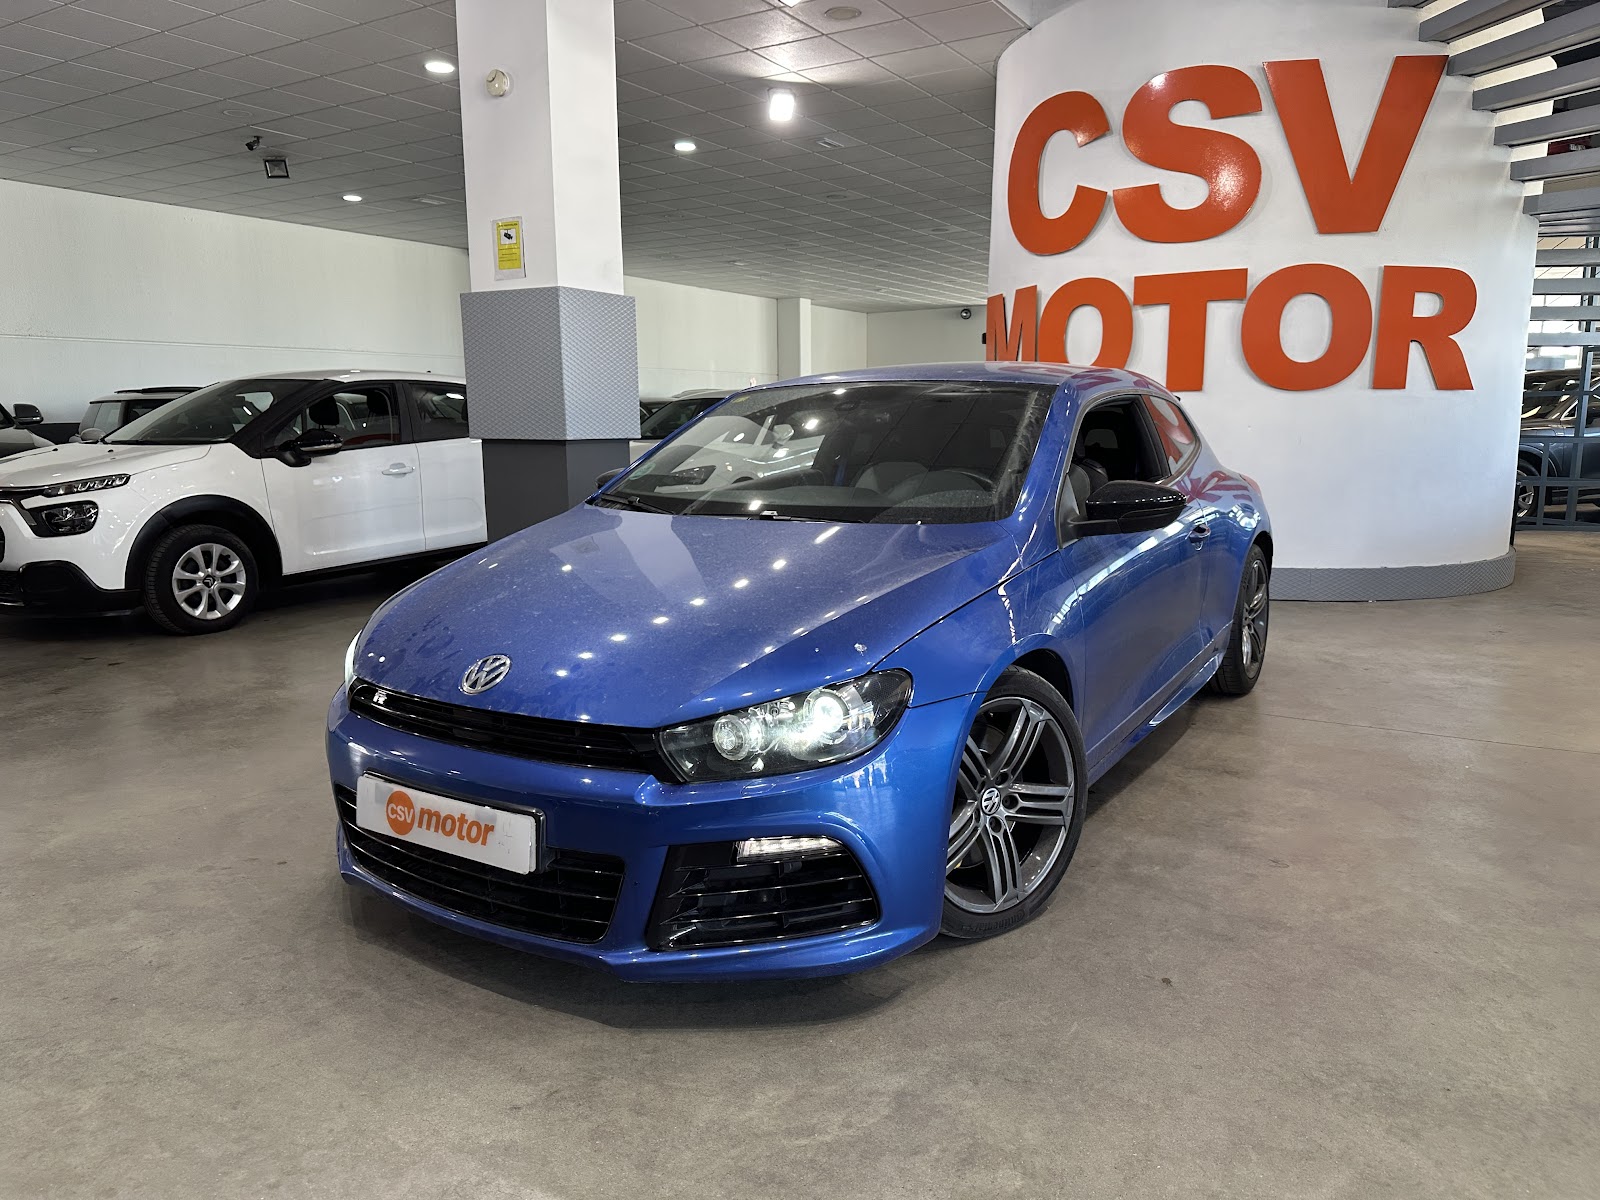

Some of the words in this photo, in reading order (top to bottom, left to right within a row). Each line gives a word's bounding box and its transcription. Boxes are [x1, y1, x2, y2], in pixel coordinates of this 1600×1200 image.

[1007, 54, 1449, 256] CSV
[986, 263, 1478, 392] MOTOR
[387, 803, 414, 823] CSV
[417, 807, 495, 846] motor
